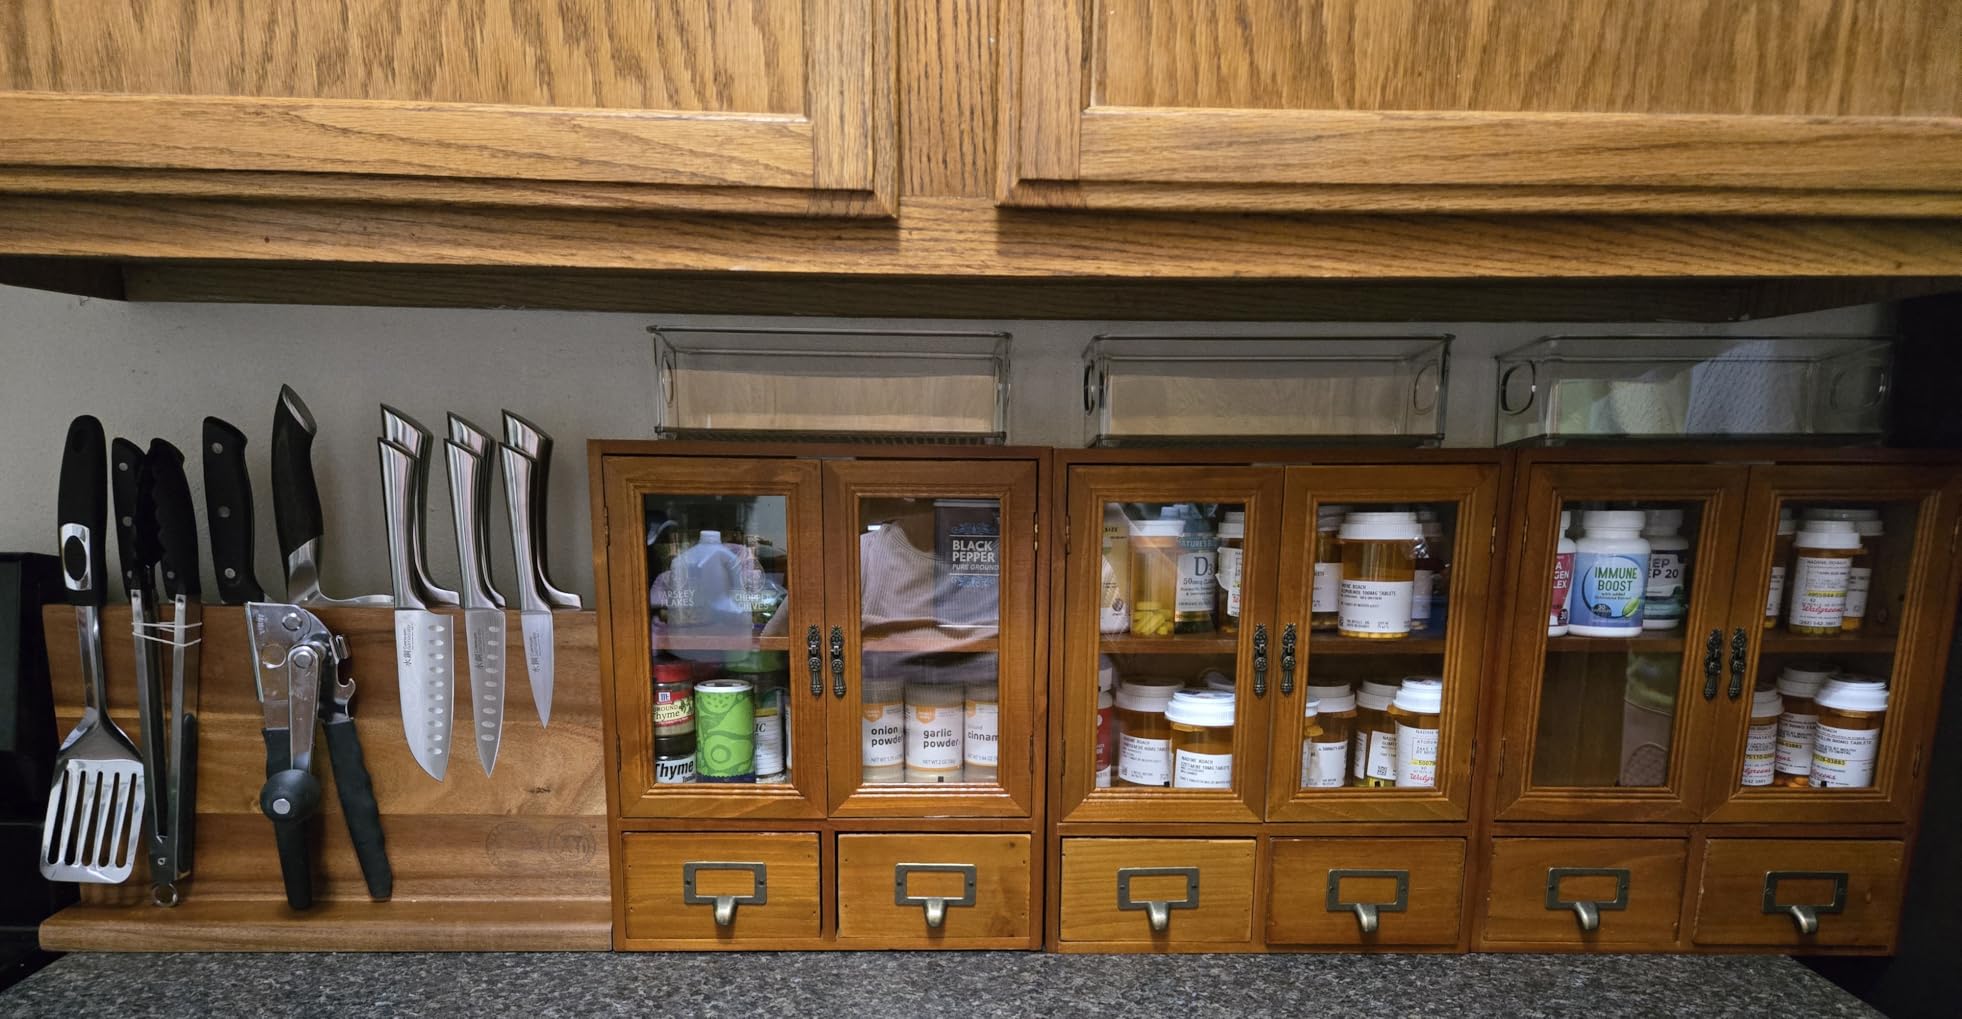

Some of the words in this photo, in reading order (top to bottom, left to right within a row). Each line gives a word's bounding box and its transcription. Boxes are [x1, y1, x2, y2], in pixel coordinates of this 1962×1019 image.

[952, 539, 993, 551] BLACK
[952, 551, 995, 562] PEPPER
[952, 563, 969, 571] PURE
[969, 563, 999, 571] GROUND
[1649, 558, 1671, 568] EP
[1594, 567, 1637, 579] IMMUNE
[1664, 568, 1679, 579] 20
[1597, 579, 1633, 592] BOOST
[656, 710, 681, 722] hyme
[871, 726, 899, 736] onion
[923, 728, 953, 739] garlic
[871, 735, 905, 748] powder
[923, 738, 959, 749] powder
[655, 760, 695, 780] Thyme
